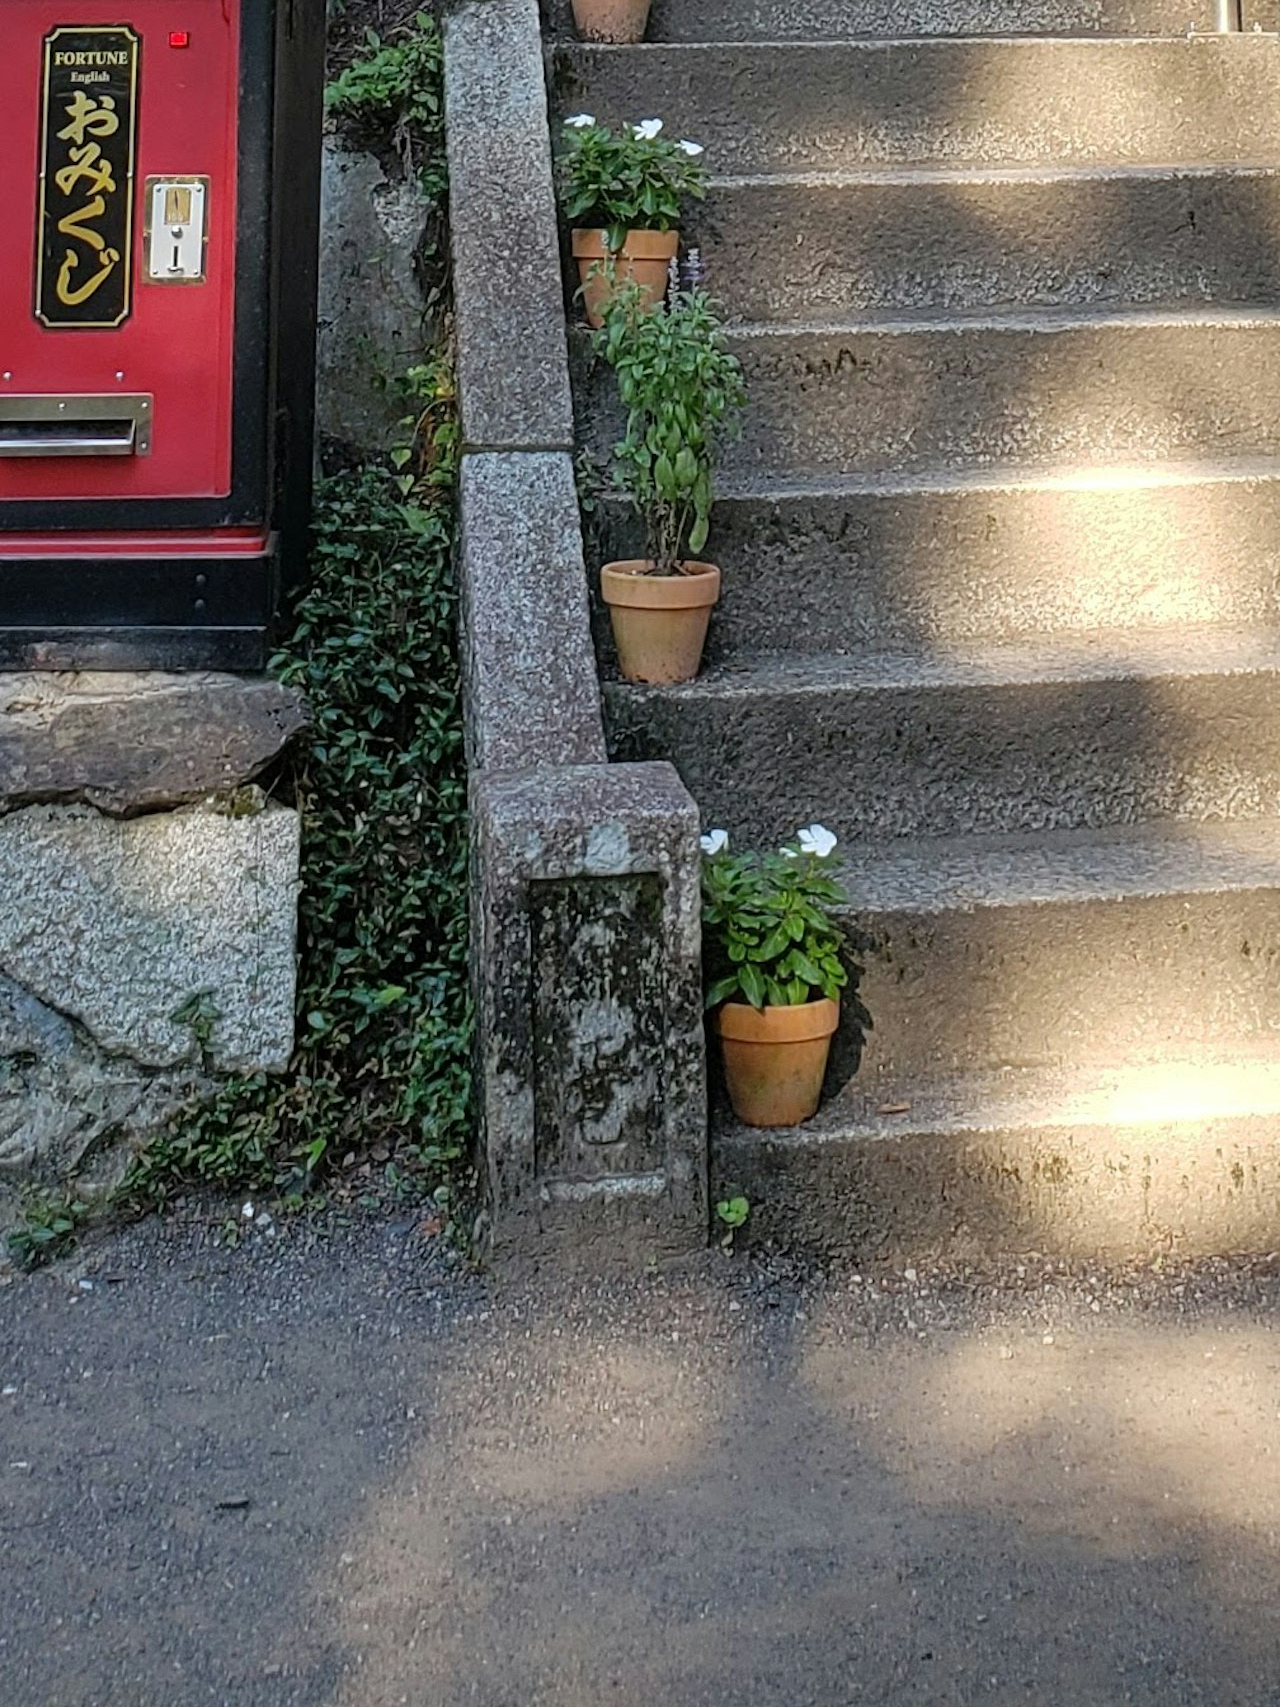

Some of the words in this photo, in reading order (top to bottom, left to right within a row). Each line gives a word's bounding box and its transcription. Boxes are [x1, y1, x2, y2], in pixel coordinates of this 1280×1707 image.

[54, 51, 128, 66] FORTUNE
[70, 71, 110, 83] English
[55, 89, 120, 305] おみくじ
